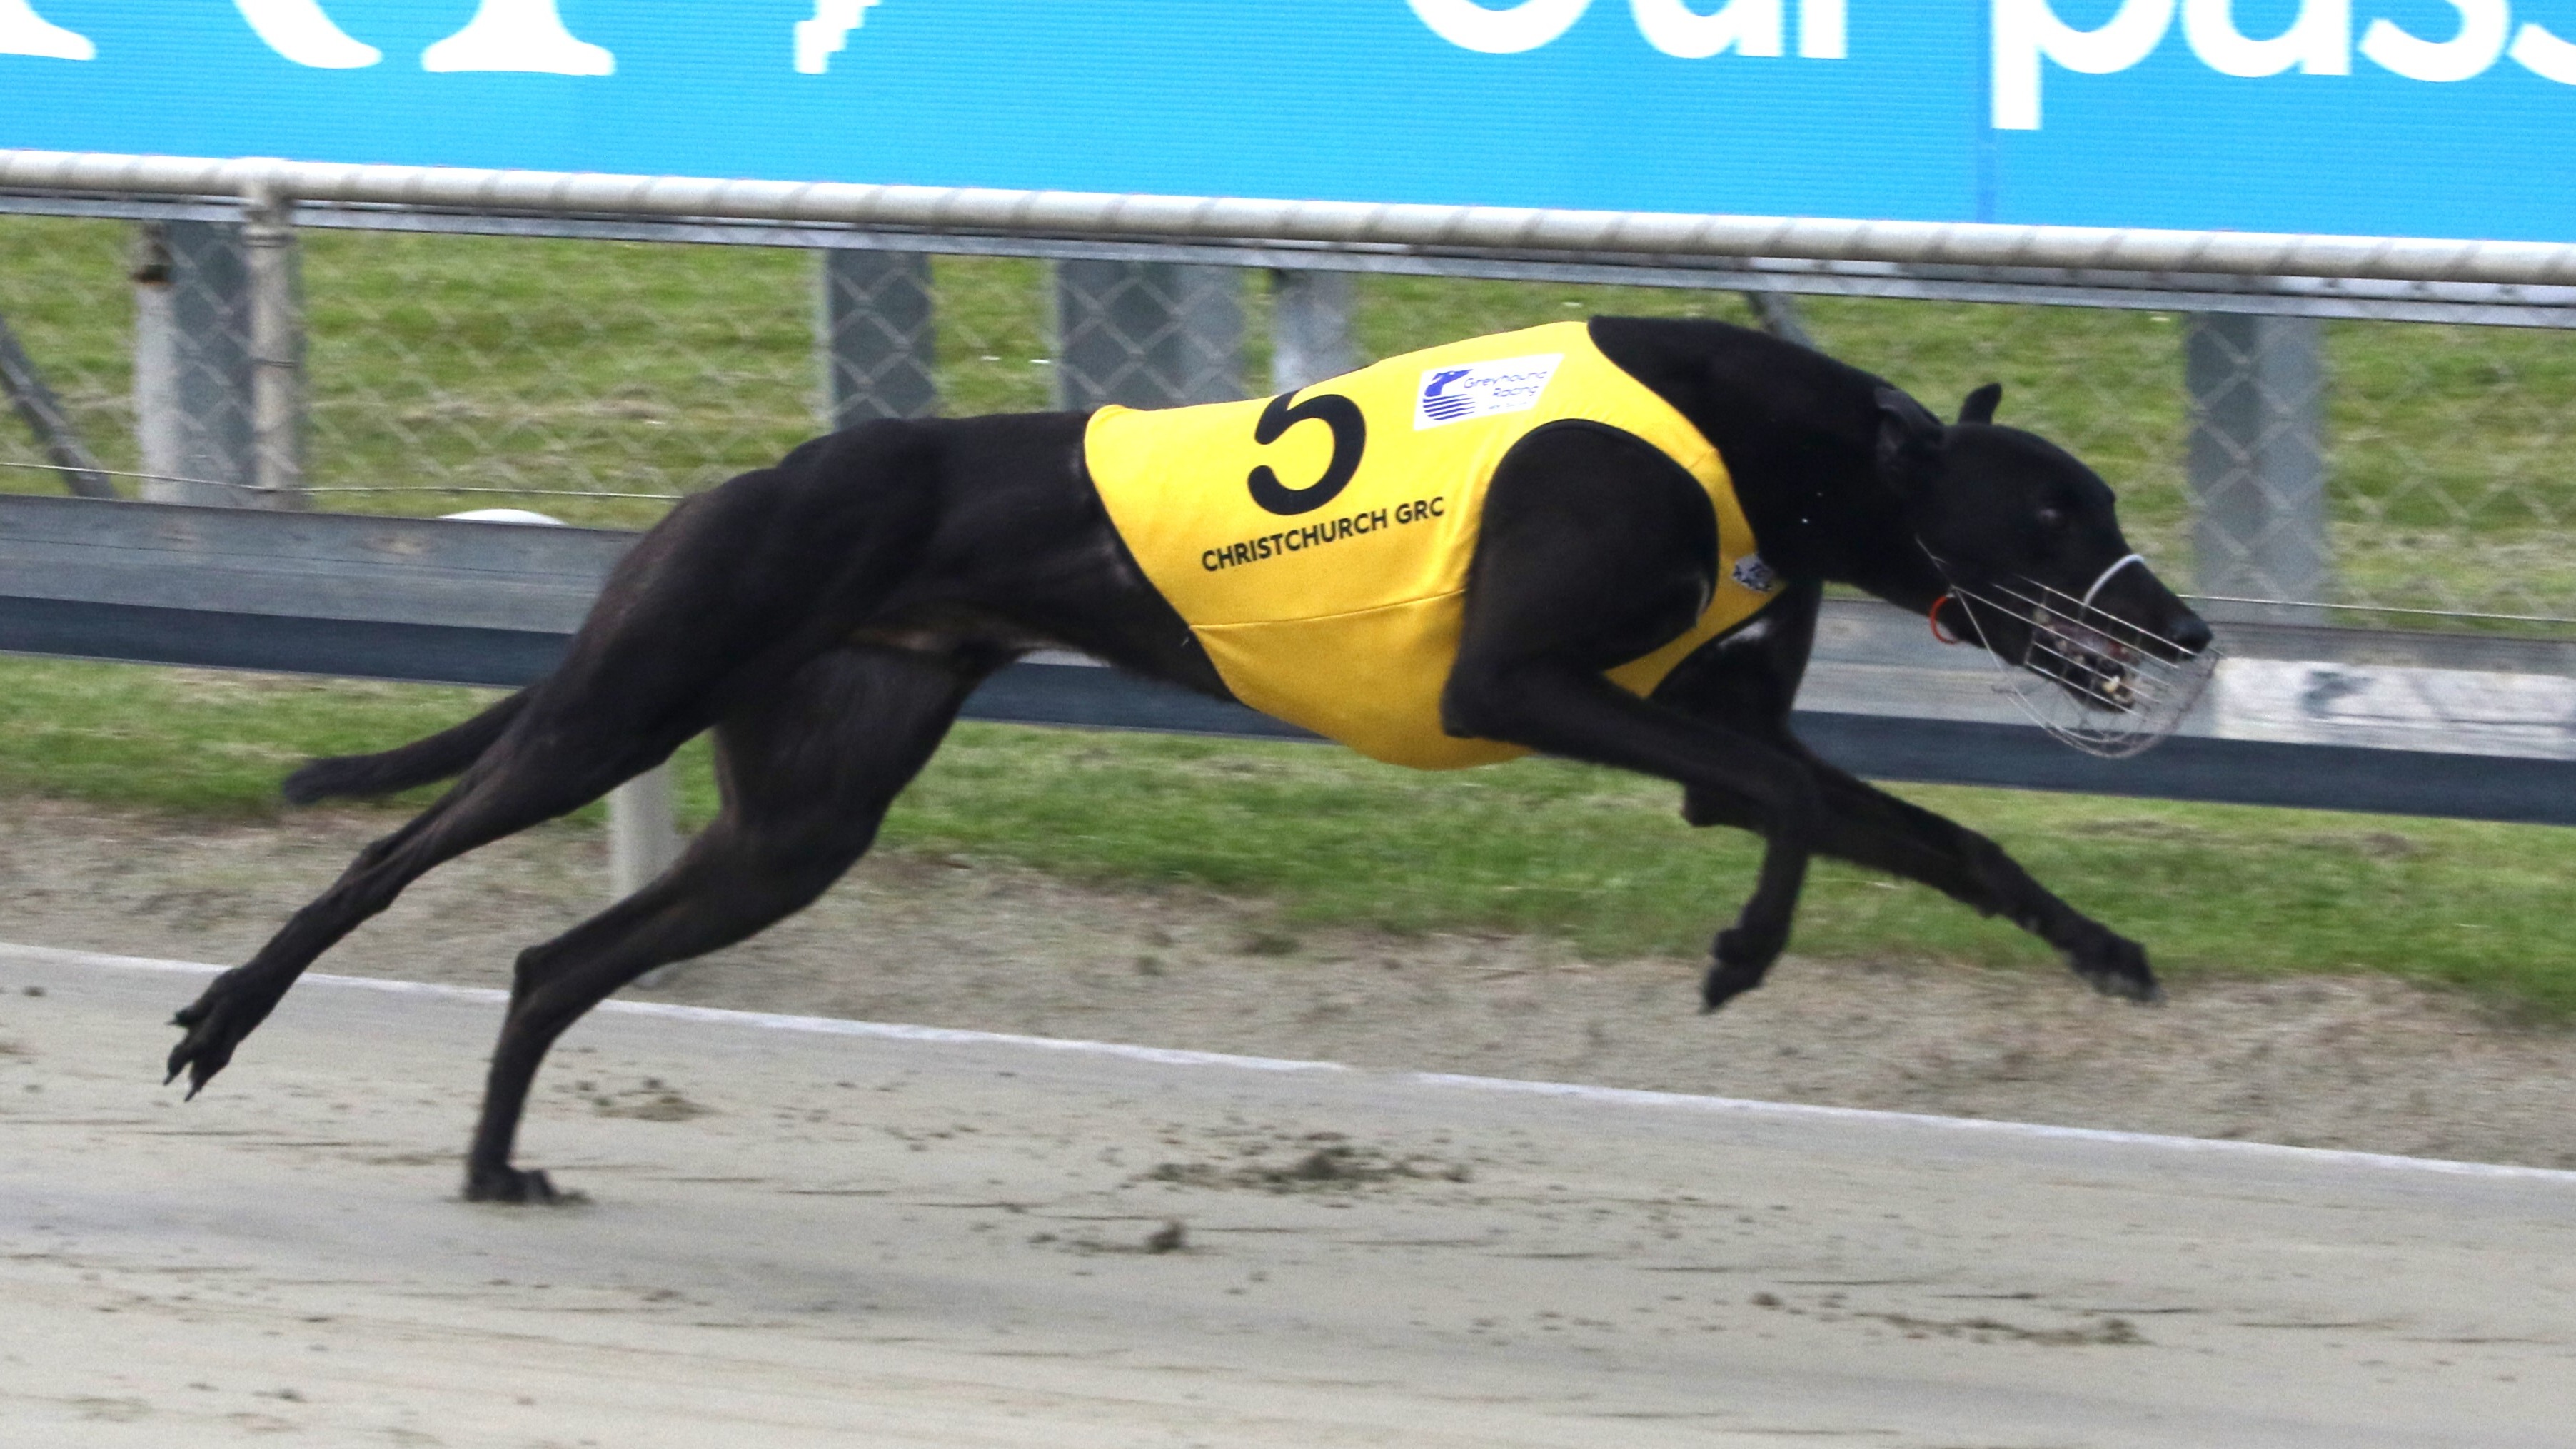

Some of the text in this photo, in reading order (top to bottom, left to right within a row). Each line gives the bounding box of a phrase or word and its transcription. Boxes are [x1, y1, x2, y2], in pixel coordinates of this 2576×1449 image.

[1247, 390, 1367, 516] 5
[1202, 496, 1445, 572] CHRISTCHURCH GRC
